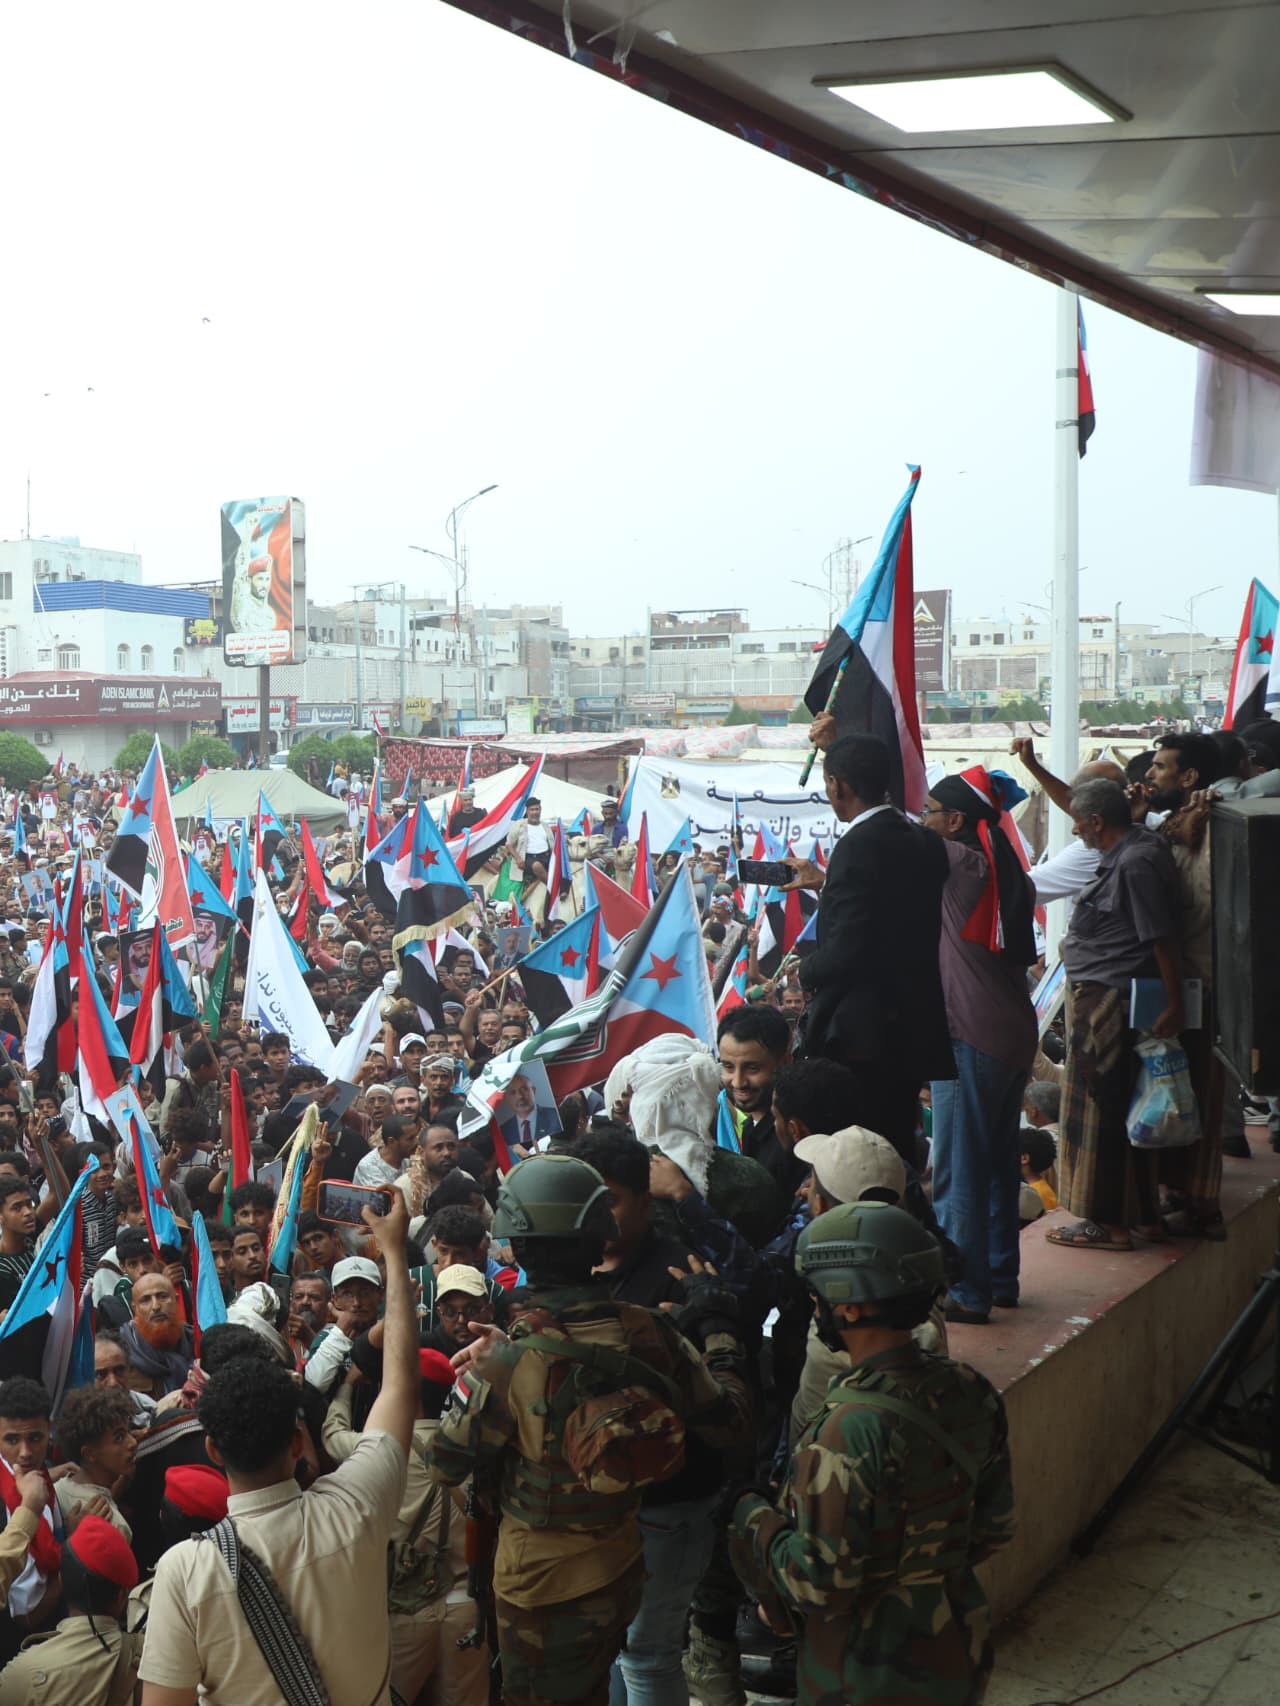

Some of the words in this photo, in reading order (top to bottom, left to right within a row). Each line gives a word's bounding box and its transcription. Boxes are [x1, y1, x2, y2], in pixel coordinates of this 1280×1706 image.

[11, 687, 45, 702] عدن
[46, 684, 80, 701] بنك
[102, 687, 118, 699] ADEN
[119, 687, 140, 699] ISLAMIC
[140, 687, 155, 699] BANK
